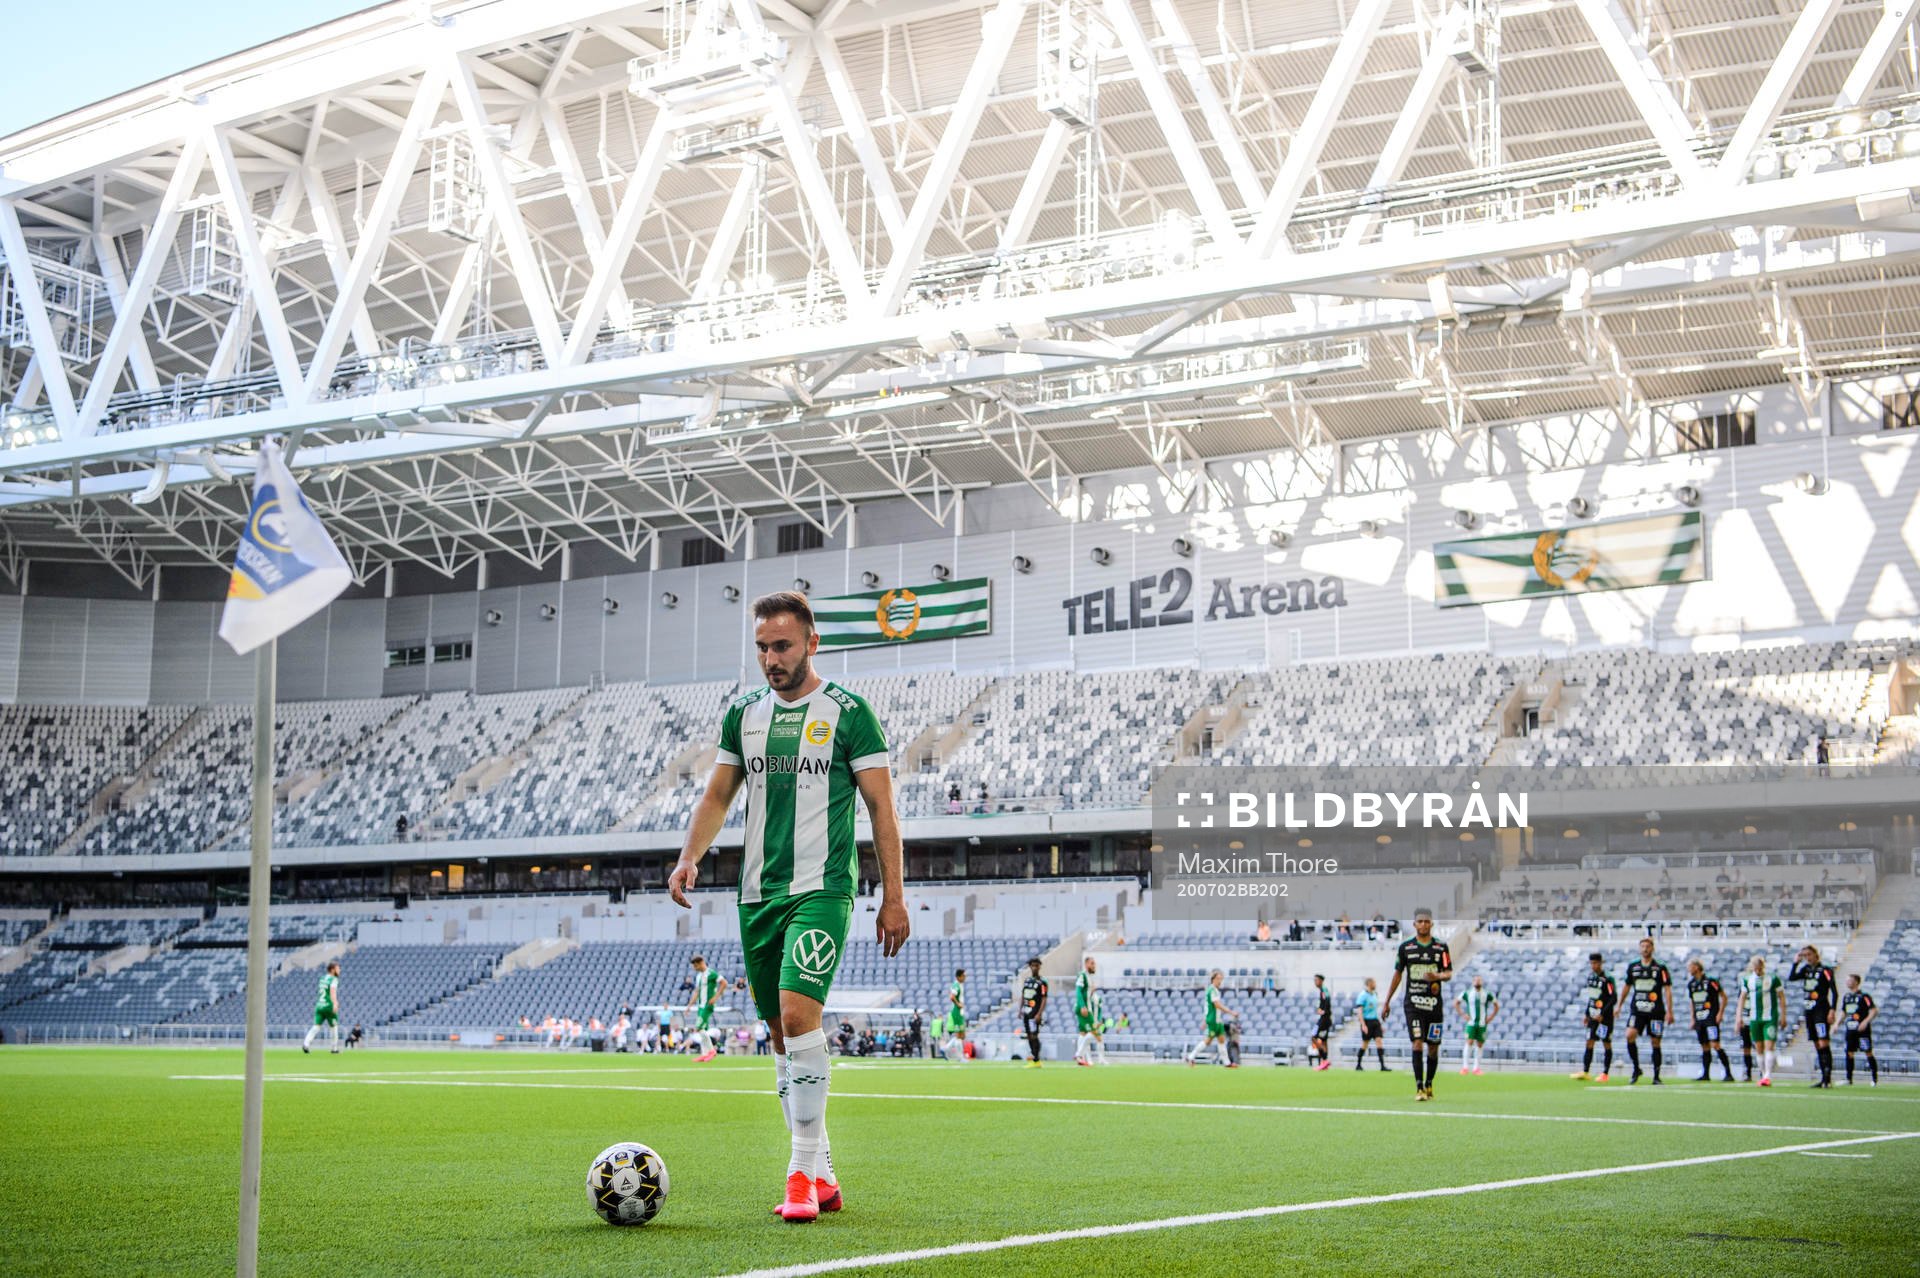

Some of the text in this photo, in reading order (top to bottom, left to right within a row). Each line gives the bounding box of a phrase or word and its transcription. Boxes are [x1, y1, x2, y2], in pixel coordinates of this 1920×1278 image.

[1062, 567, 1348, 636] TELE2 Arena
[826, 687, 859, 713] BST
[799, 973, 822, 985] CRAFT
